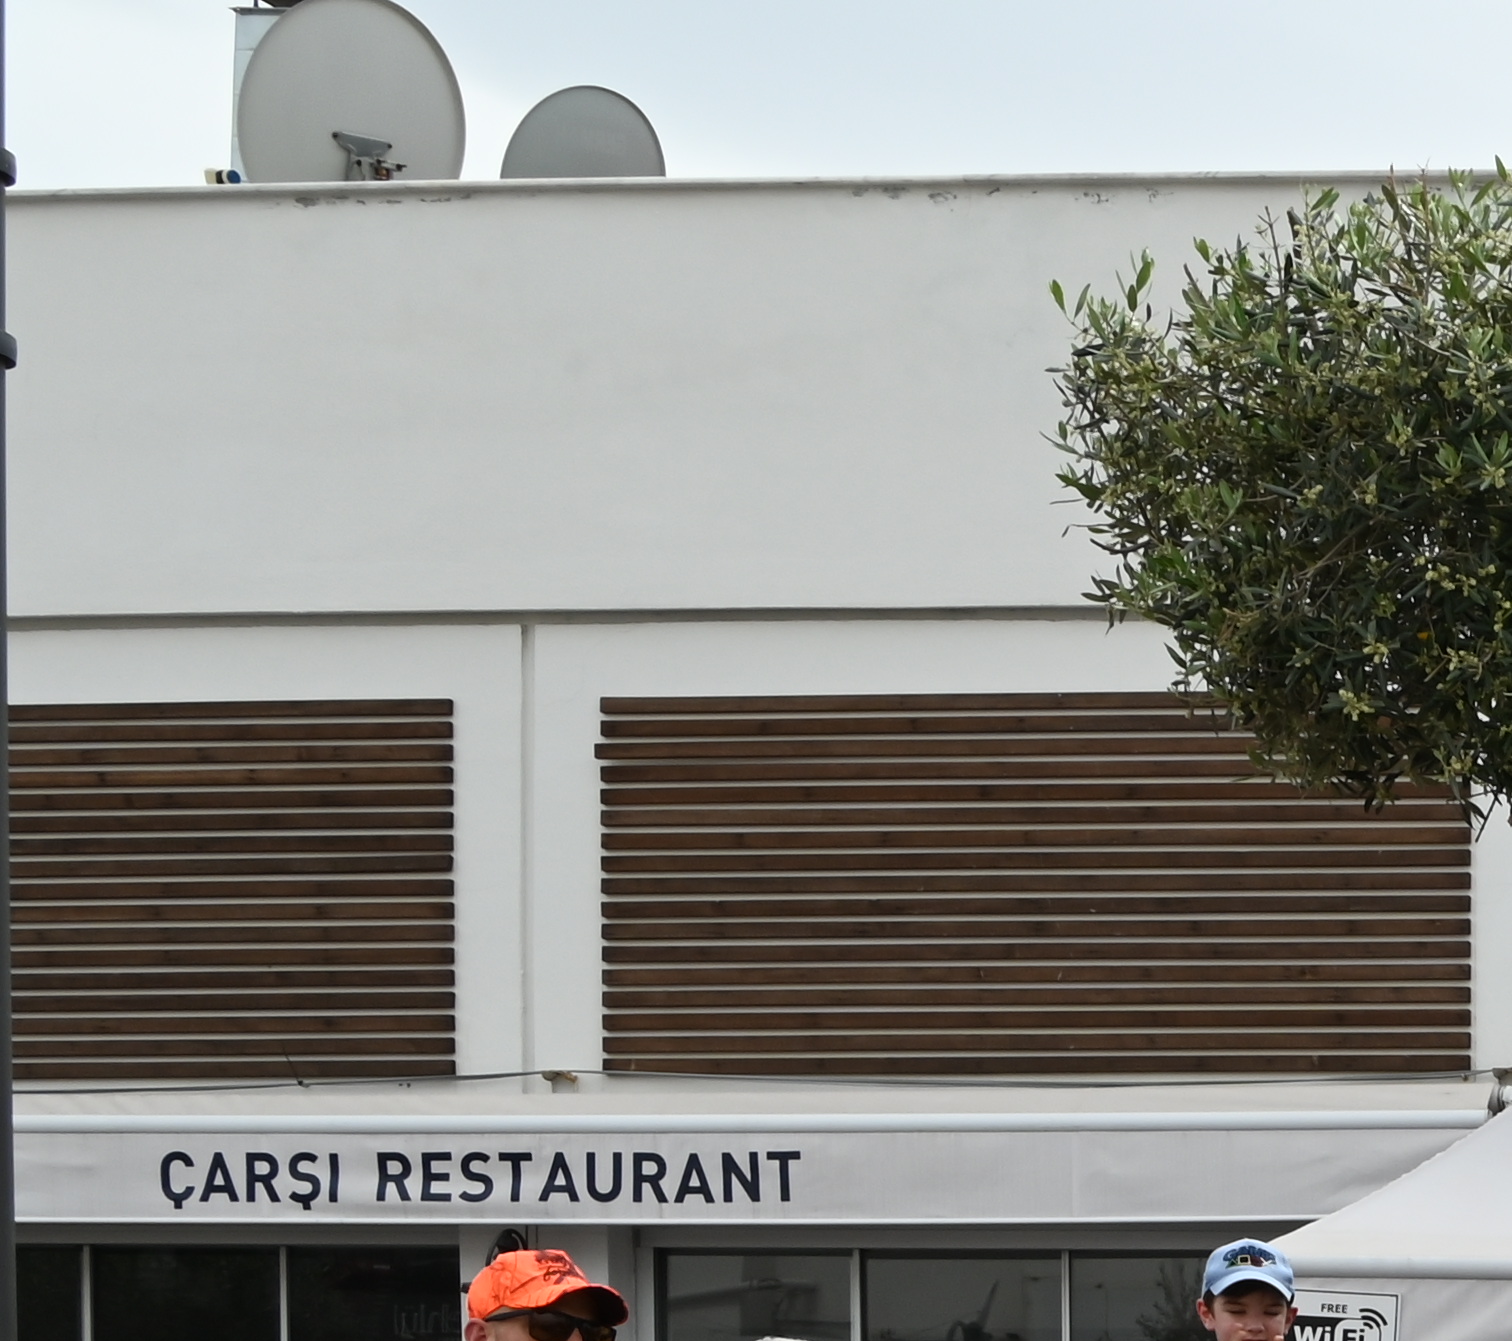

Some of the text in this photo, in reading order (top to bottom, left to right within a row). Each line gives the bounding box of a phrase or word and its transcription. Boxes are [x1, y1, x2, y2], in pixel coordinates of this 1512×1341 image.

[160, 1150, 802, 1211] ÇARŞI RESTAURANT
[1320, 1303, 1349, 1315] FREE
